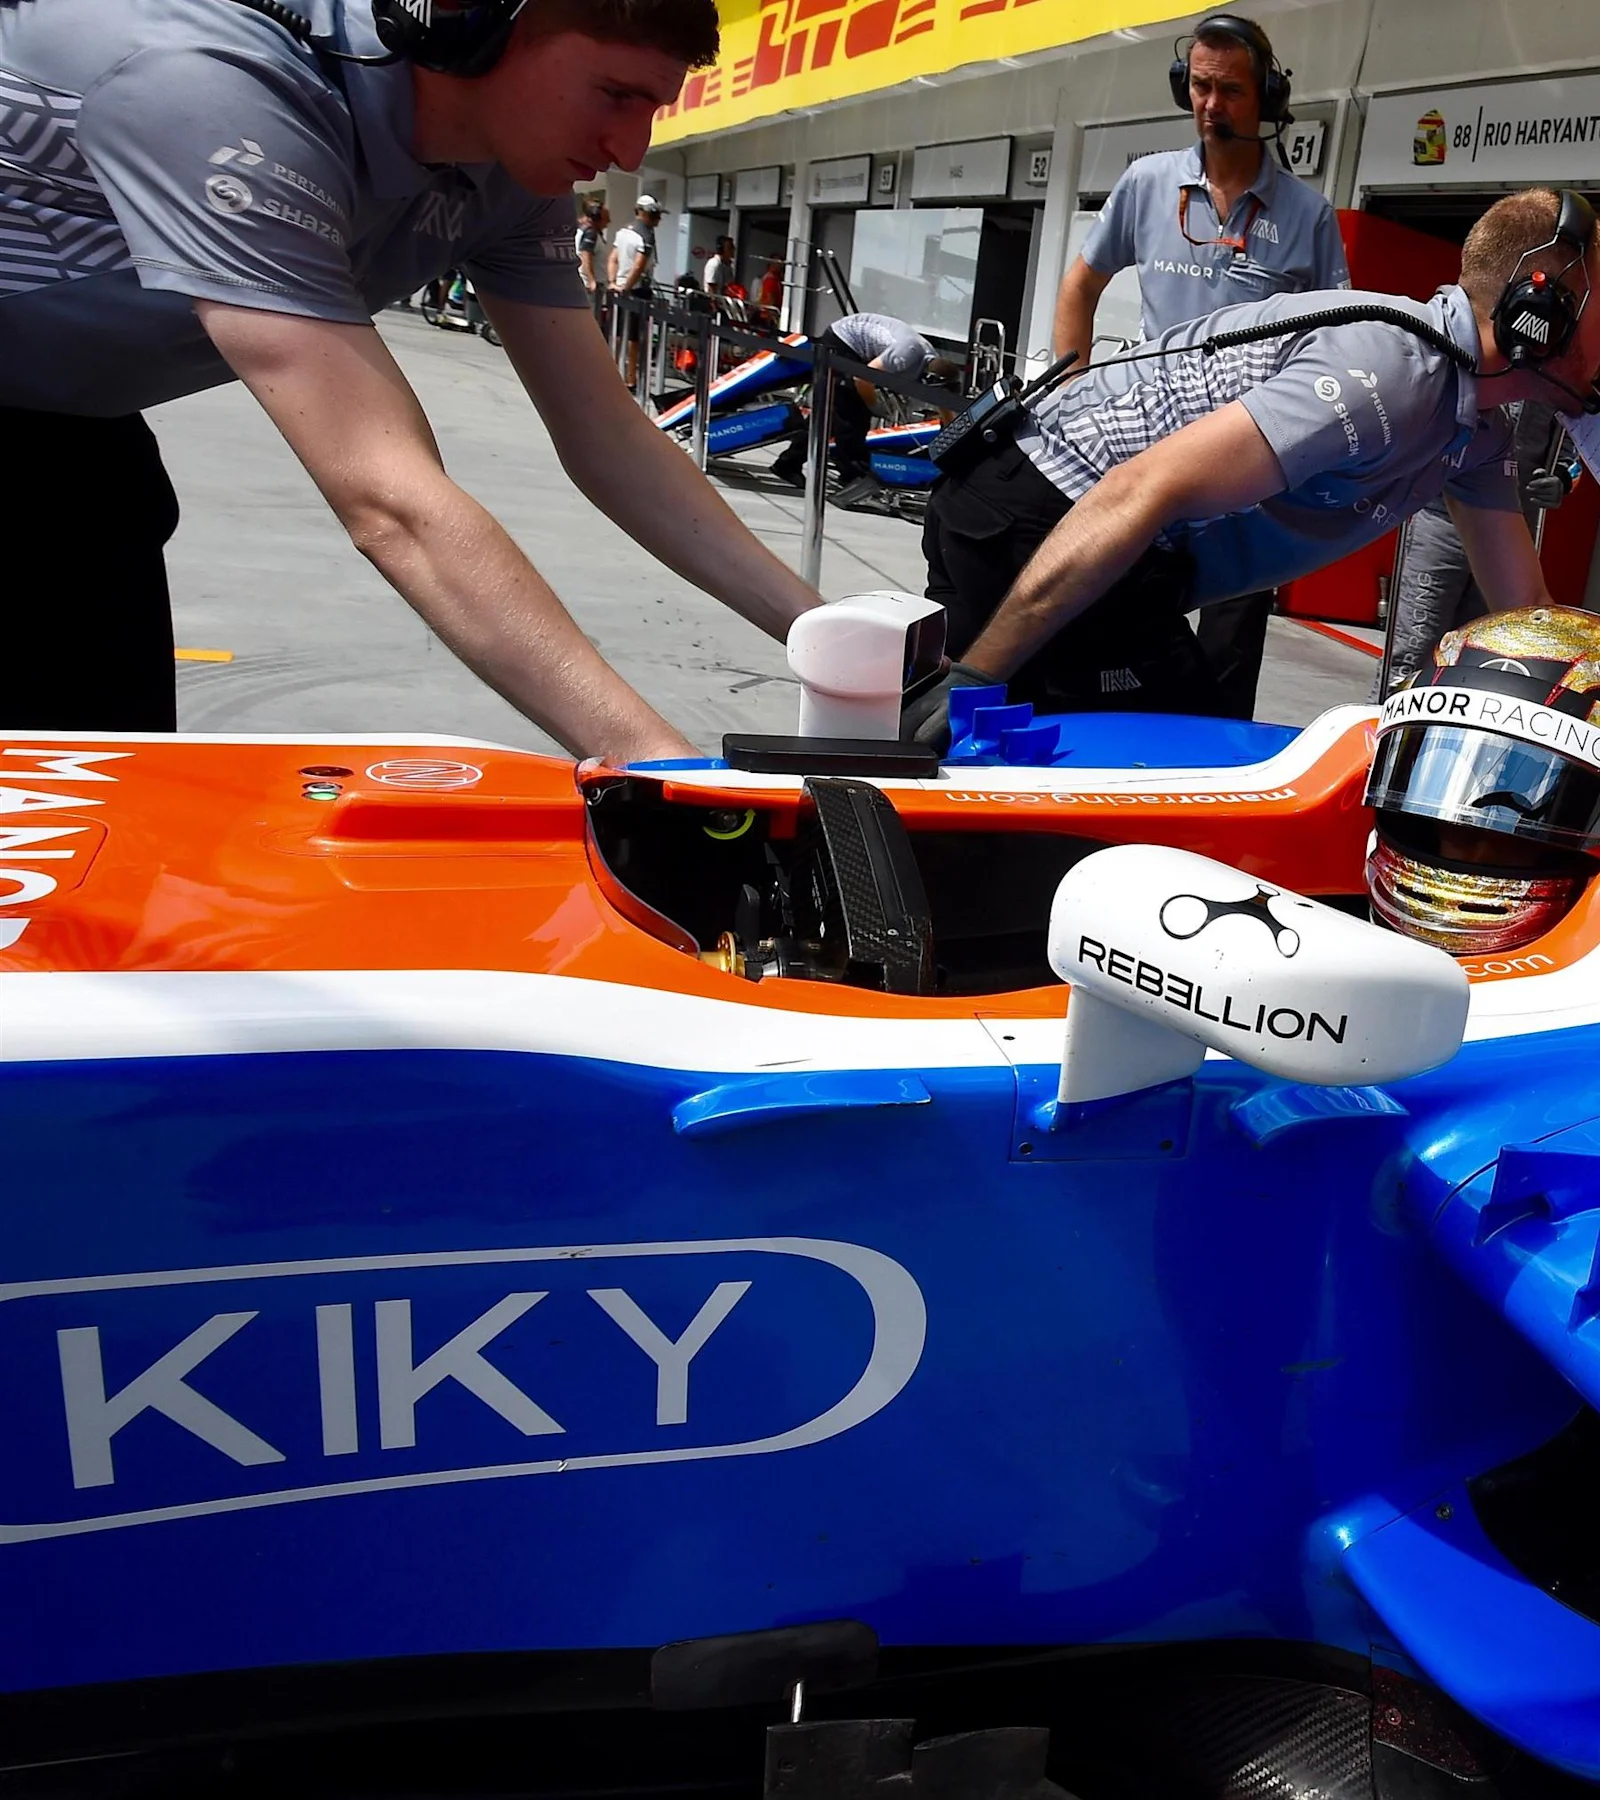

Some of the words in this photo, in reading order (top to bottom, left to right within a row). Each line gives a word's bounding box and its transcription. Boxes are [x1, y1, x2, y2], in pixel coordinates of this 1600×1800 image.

[1453, 124, 1471, 149] 88
[1483, 119, 1510, 148] RIO
[1290, 135, 1314, 166] 51
[1032, 156, 1048, 179] 52
[273, 162, 347, 221] PERTAMIN
[1153, 259, 1214, 280] MANOR
[709, 423, 744, 440] MANOR
[1370, 391, 1393, 447] PERTAMINA
[873, 461, 907, 472] MANOR
[1389, 651, 1418, 688] NOR
[1407, 571, 1432, 649] RACING
[1383, 691, 1470, 724] MANOR
[0, 747, 137, 950] MANO
[56, 1280, 753, 1489] KIKY
